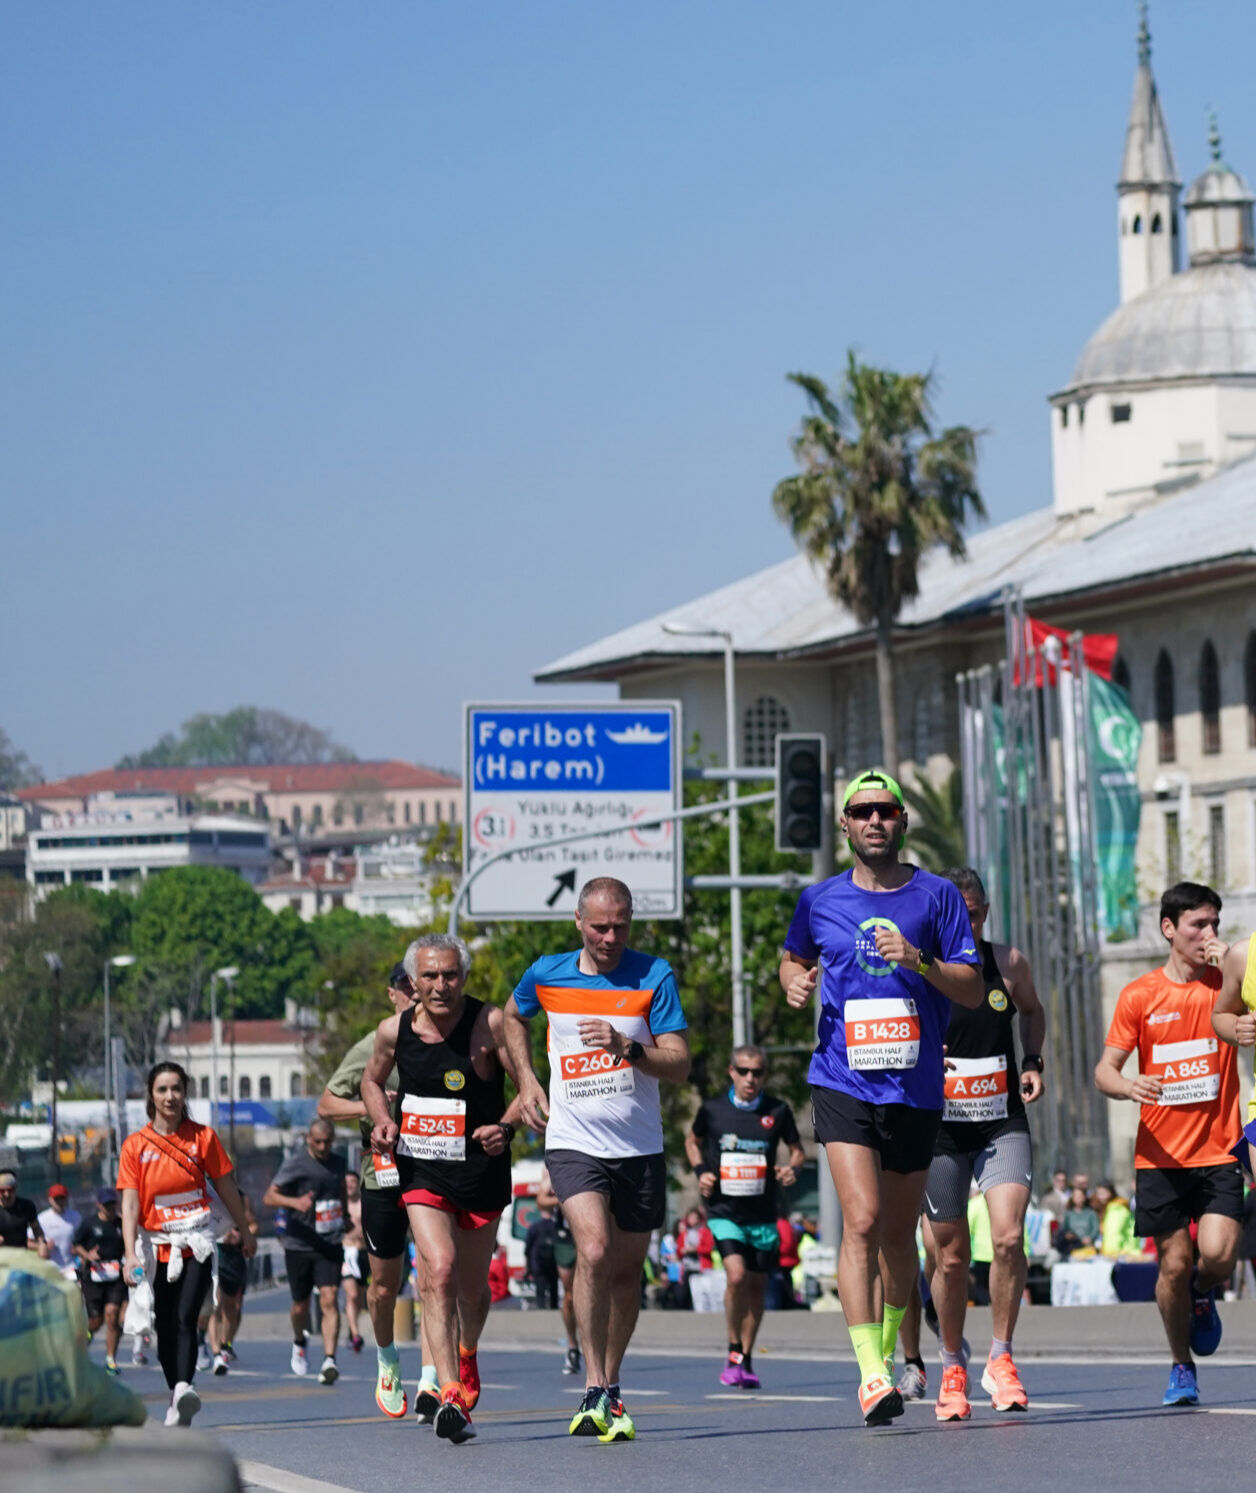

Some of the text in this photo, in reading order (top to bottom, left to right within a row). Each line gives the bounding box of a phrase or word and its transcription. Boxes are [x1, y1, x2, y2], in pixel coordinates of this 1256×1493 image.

[479, 720, 596, 747] Feribot
[475, 754, 605, 786] (Harem)
[854, 1022, 911, 1040] B 1428
[564, 1057, 577, 1074] C
[854, 1056, 903, 1066] MARATHON
[1163, 1059, 1210, 1080] A 865
[569, 1086, 617, 1099] MARATHON
[953, 1077, 998, 1095] A 694
[1164, 1090, 1208, 1102] MARATHON
[948, 1109, 994, 1118] MARATHON
[407, 1115, 457, 1134] F 5245
[405, 1145, 448, 1158] MARATHON
